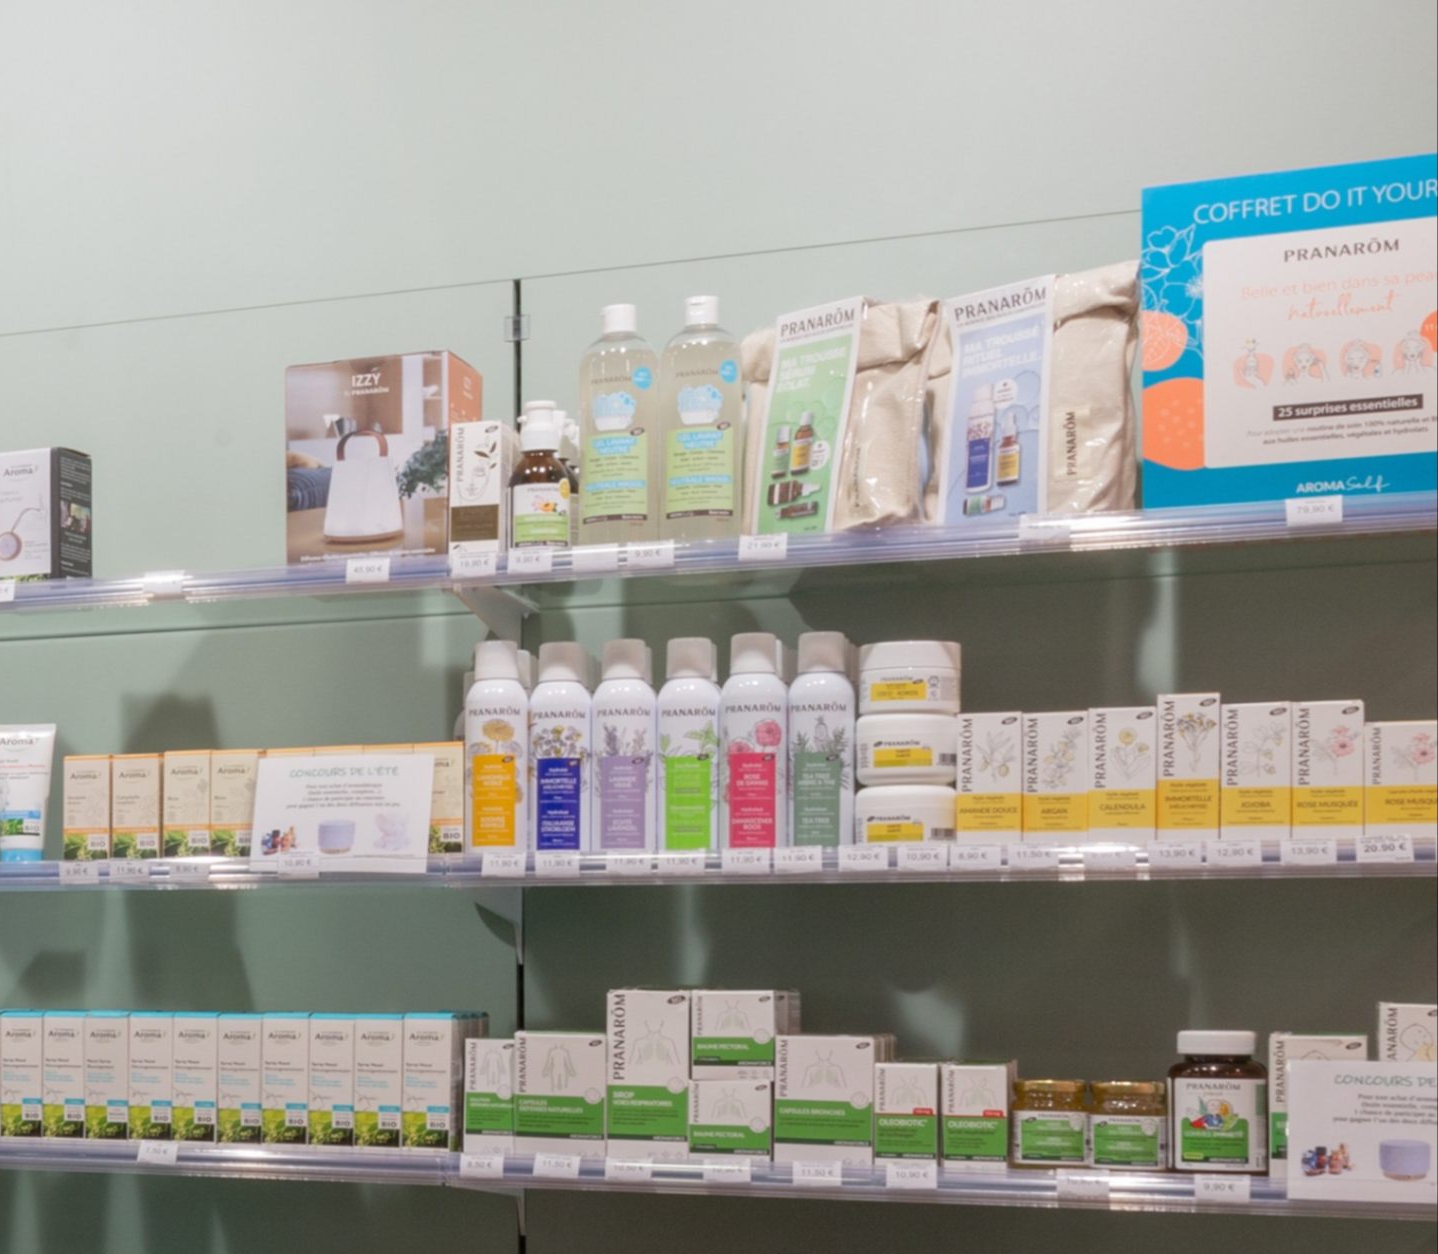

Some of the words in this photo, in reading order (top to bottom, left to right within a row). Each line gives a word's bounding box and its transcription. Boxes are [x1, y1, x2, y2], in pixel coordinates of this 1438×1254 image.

[1193, 194, 1297, 224] COFFRET
[1302, 189, 1341, 213] DO
[1347, 186, 1367, 207] IT
[1241, 285, 1278, 300] Belle
[1282, 284, 1296, 297] et
[1301, 278, 1336, 295] bien
[1341, 274, 1379, 291] dans
[1383, 274, 1400, 286] sa
[351, 371, 381, 388] IZZY
[1278, 406, 1293, 418] 25
[1294, 402, 1348, 418] surprises
[1349, 397, 1418, 412] essentielles
[289, 767, 347, 779] CONCOURS
[350, 767, 364, 777] DE
[959, 806, 991, 815] AMANDE
[992, 806, 1018, 815] DOUCE
[1099, 803, 1146, 812] CALENDULA
[1297, 800, 1317, 809] ROSE
[1397, 843, 1407, 852] €
[1334, 1073, 1413, 1088] CONCOURS
